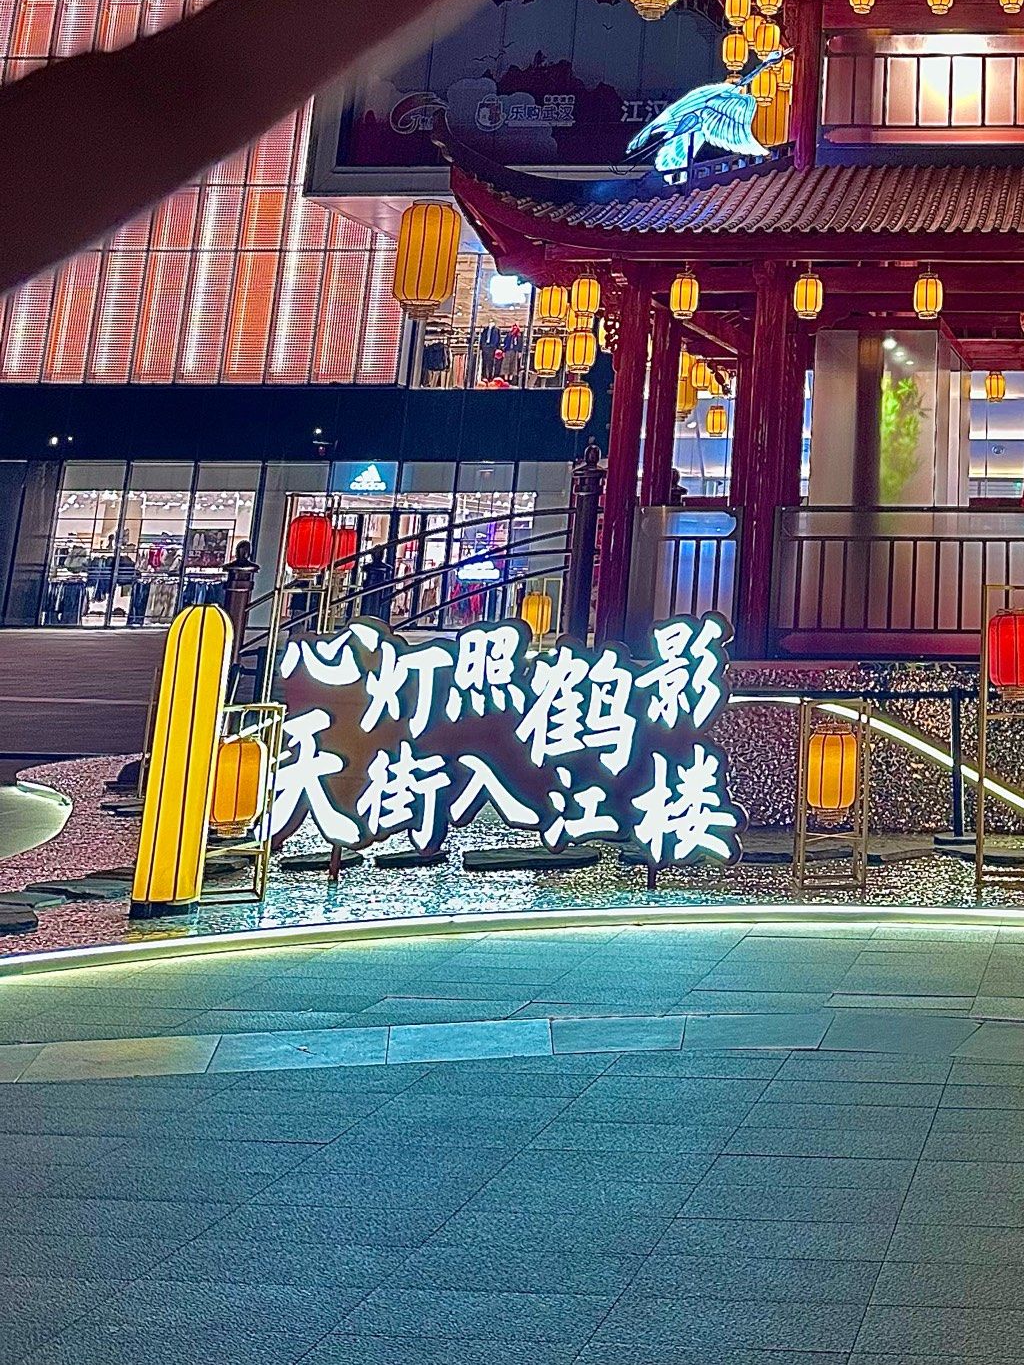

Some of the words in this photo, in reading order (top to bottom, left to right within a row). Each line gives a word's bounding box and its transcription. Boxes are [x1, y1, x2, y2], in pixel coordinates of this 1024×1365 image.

[508, 104, 575, 121] 乐购武汉
[280, 618, 725, 776] 心灯照鹤影
[256, 707, 738, 863] 天街入江楼
